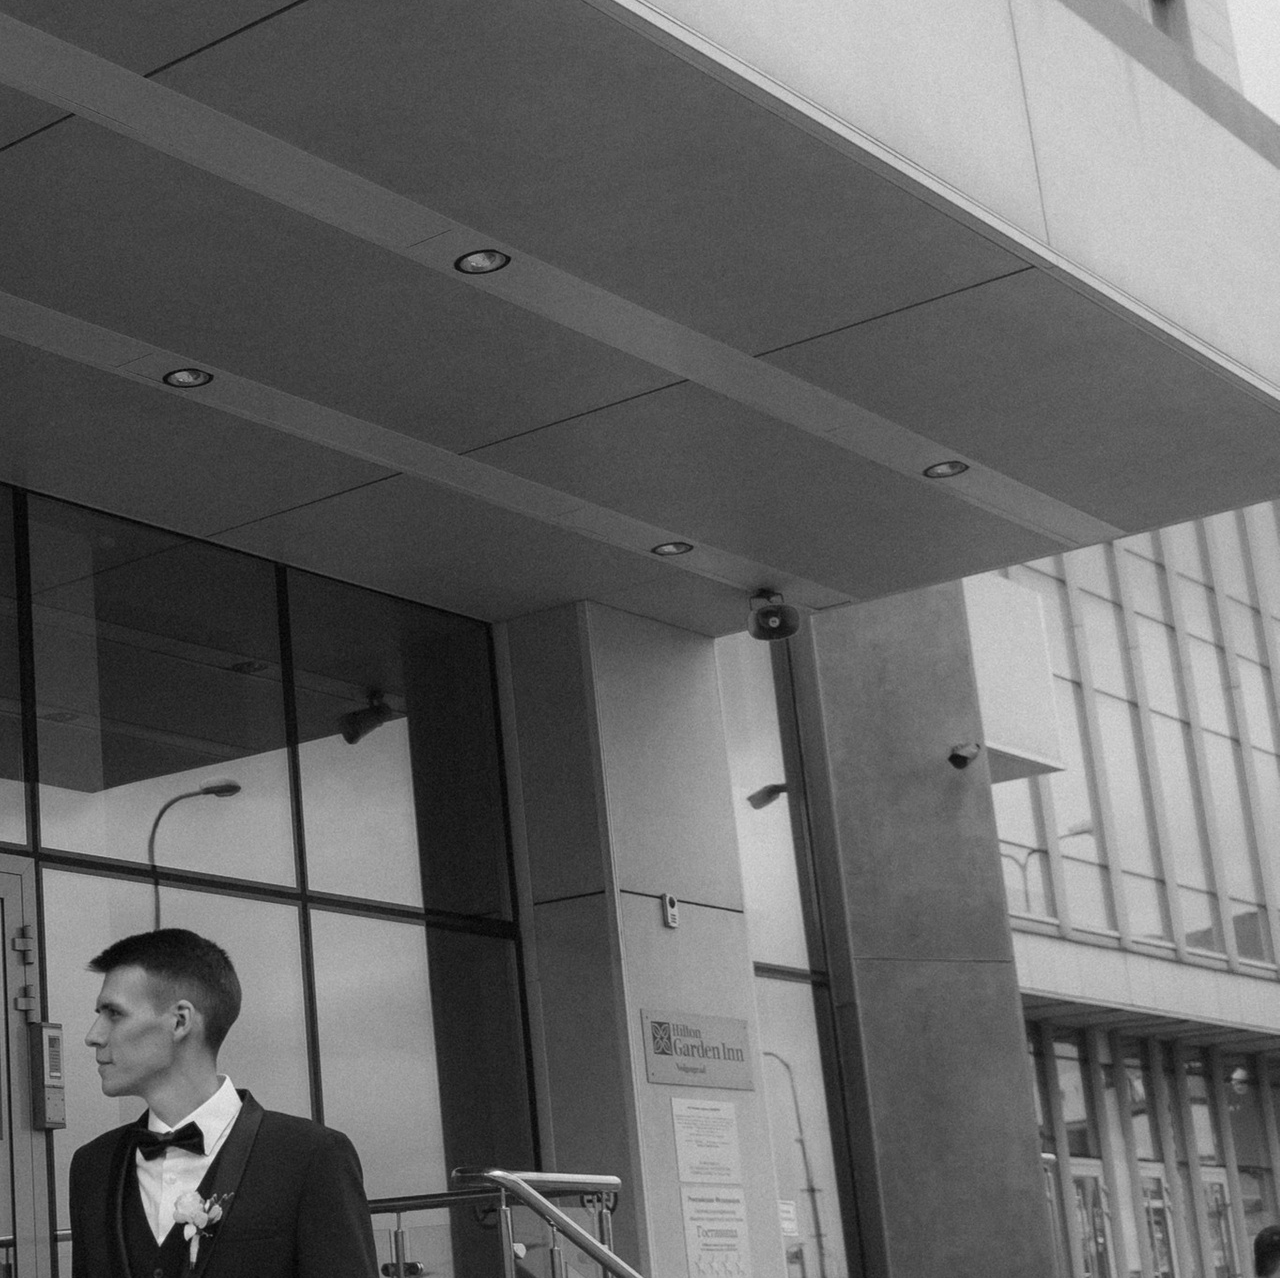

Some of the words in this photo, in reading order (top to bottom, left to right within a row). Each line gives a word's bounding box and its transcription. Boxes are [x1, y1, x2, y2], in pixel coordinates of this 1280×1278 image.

[672, 1023, 702, 1039] Hilton
[673, 1038, 721, 1060] Garden
[721, 1042, 745, 1062] Inn
